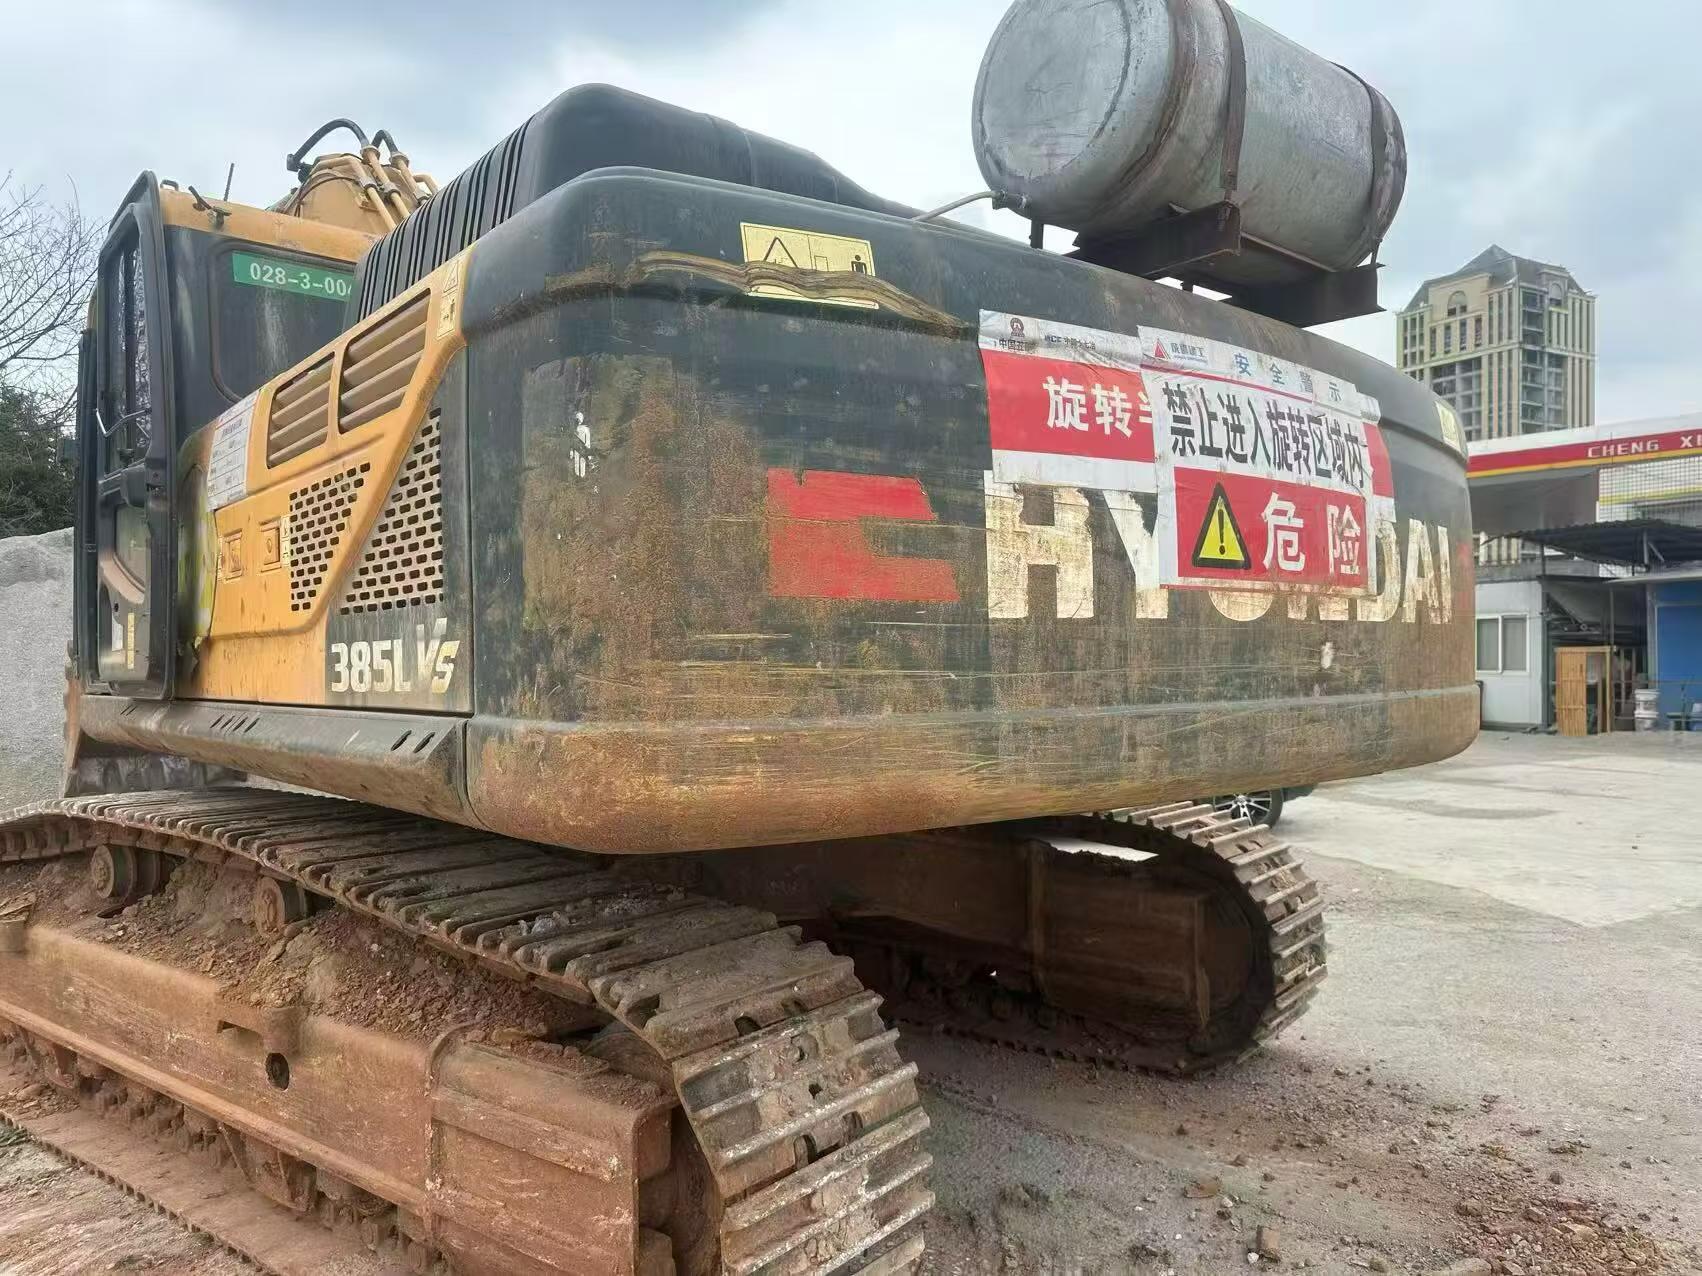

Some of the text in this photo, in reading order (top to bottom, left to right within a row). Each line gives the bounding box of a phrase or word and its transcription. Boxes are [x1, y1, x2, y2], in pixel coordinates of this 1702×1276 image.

[249, 262, 352, 296] 028-3-00
[1162, 381, 1366, 489] 禁止进入旋转区域内
[1587, 439, 1660, 458] CHENG
[984, 470, 1452, 624] HYDAI
[1262, 491, 1362, 575] 危险
